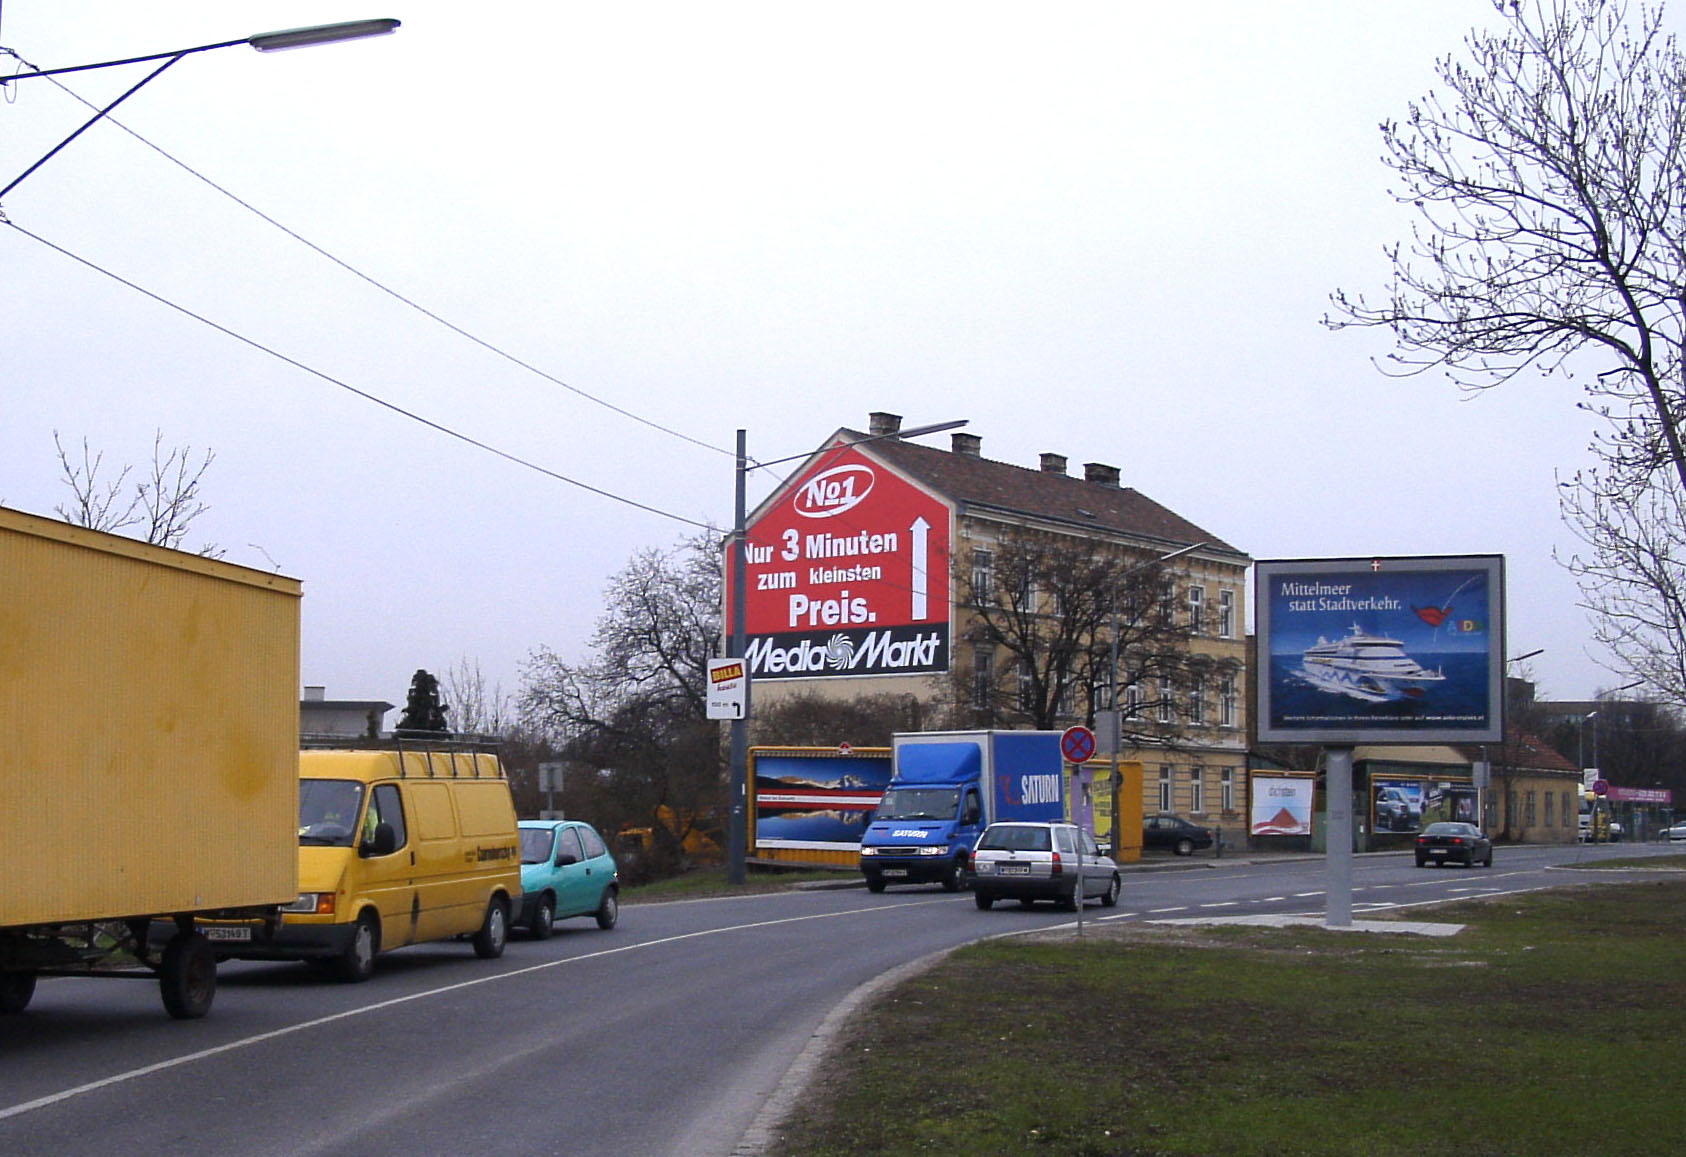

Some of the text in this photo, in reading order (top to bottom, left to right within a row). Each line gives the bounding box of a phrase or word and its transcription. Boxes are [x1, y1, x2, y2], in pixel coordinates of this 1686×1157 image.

[781, 528, 799, 561] 3
[805, 530, 898, 559] Minuten
[757, 564, 881, 590] zum kleinsten
[1281, 581, 1352, 596] Mittelmeer
[789, 590, 877, 627] Preis.
[1288, 596, 1402, 612] statt Stadtverkehr.
[745, 630, 940, 673] Media Markt
[711, 664, 743, 682] BILLA
[1022, 774, 1059, 805] SATURN
[892, 829, 928, 838] SATURN
